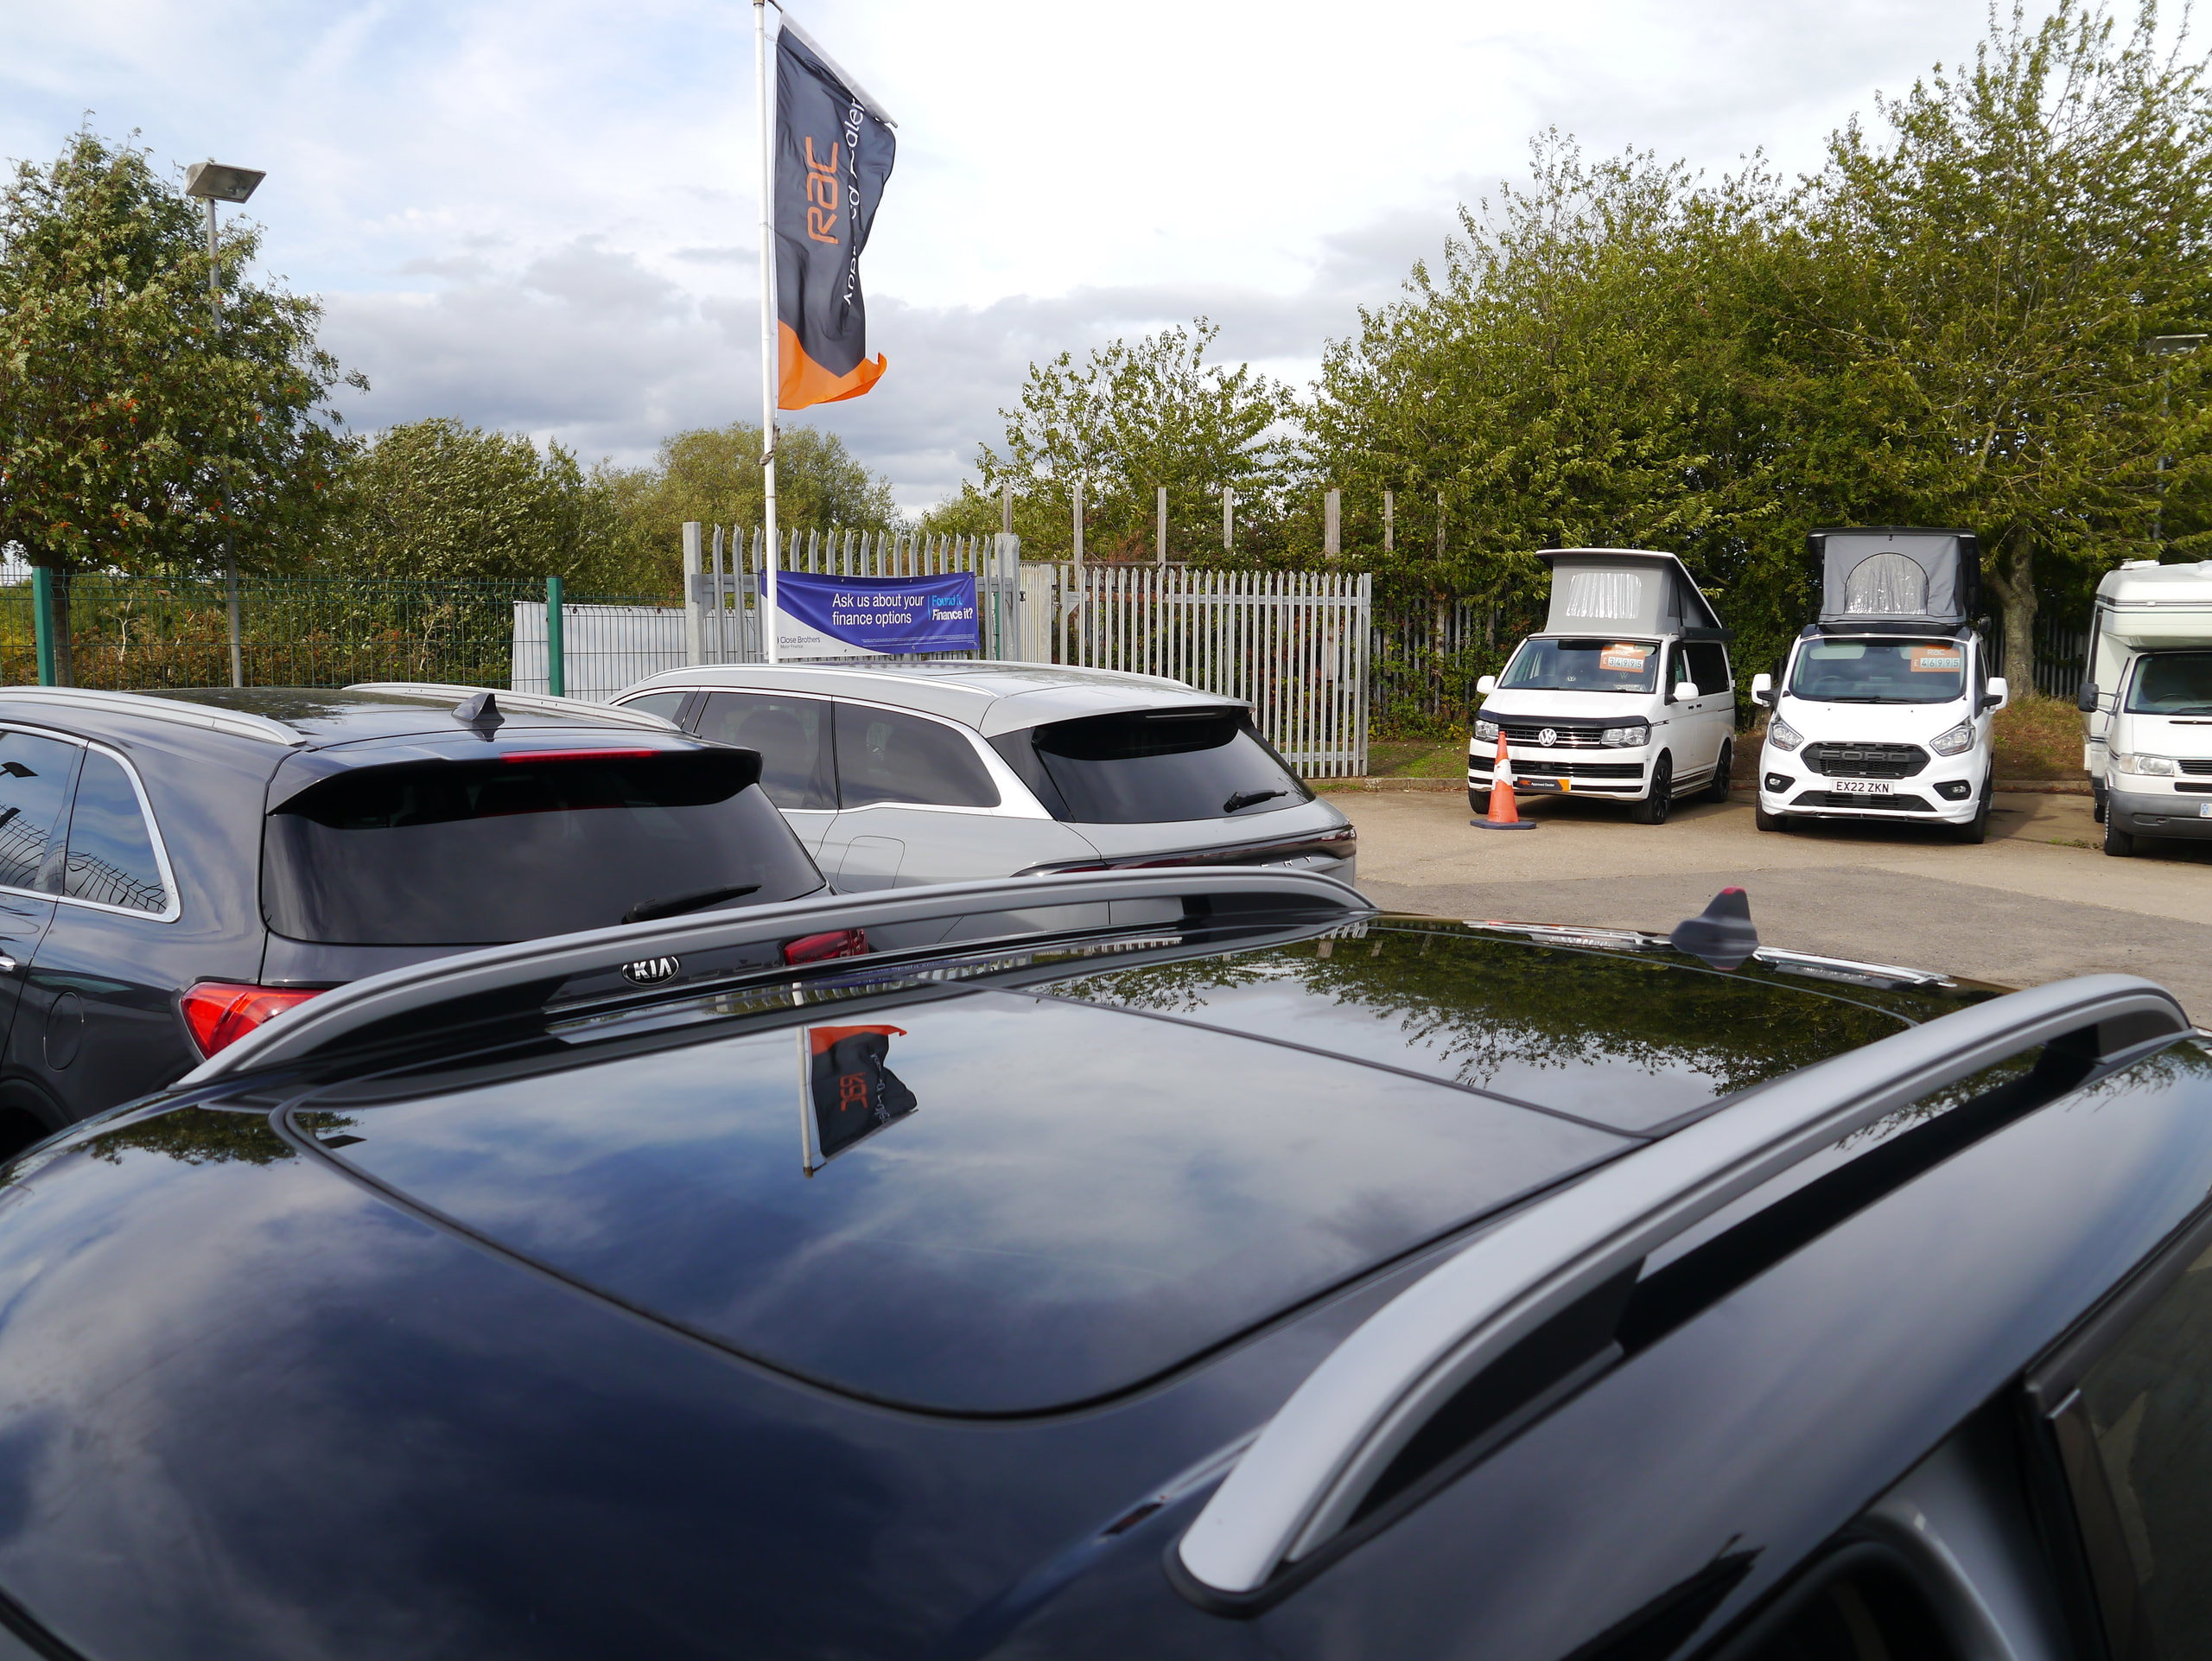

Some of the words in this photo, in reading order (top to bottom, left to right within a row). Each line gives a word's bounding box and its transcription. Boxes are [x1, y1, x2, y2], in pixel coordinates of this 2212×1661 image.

[832, 593, 855, 608] Ask
[857, 595, 870, 608] us
[873, 593, 901, 608] about
[904, 595, 925, 610] your
[932, 595, 956, 606] Found
[832, 611, 873, 626] finance
[875, 610, 912, 627] options
[932, 608, 963, 620] Finance
[963, 607, 973, 620] it?
[1820, 750, 1910, 760] FORD
[1836, 781, 1865, 792] EX22
[1867, 783, 1890, 792] ZKN
[633, 958, 672, 979] KIA
